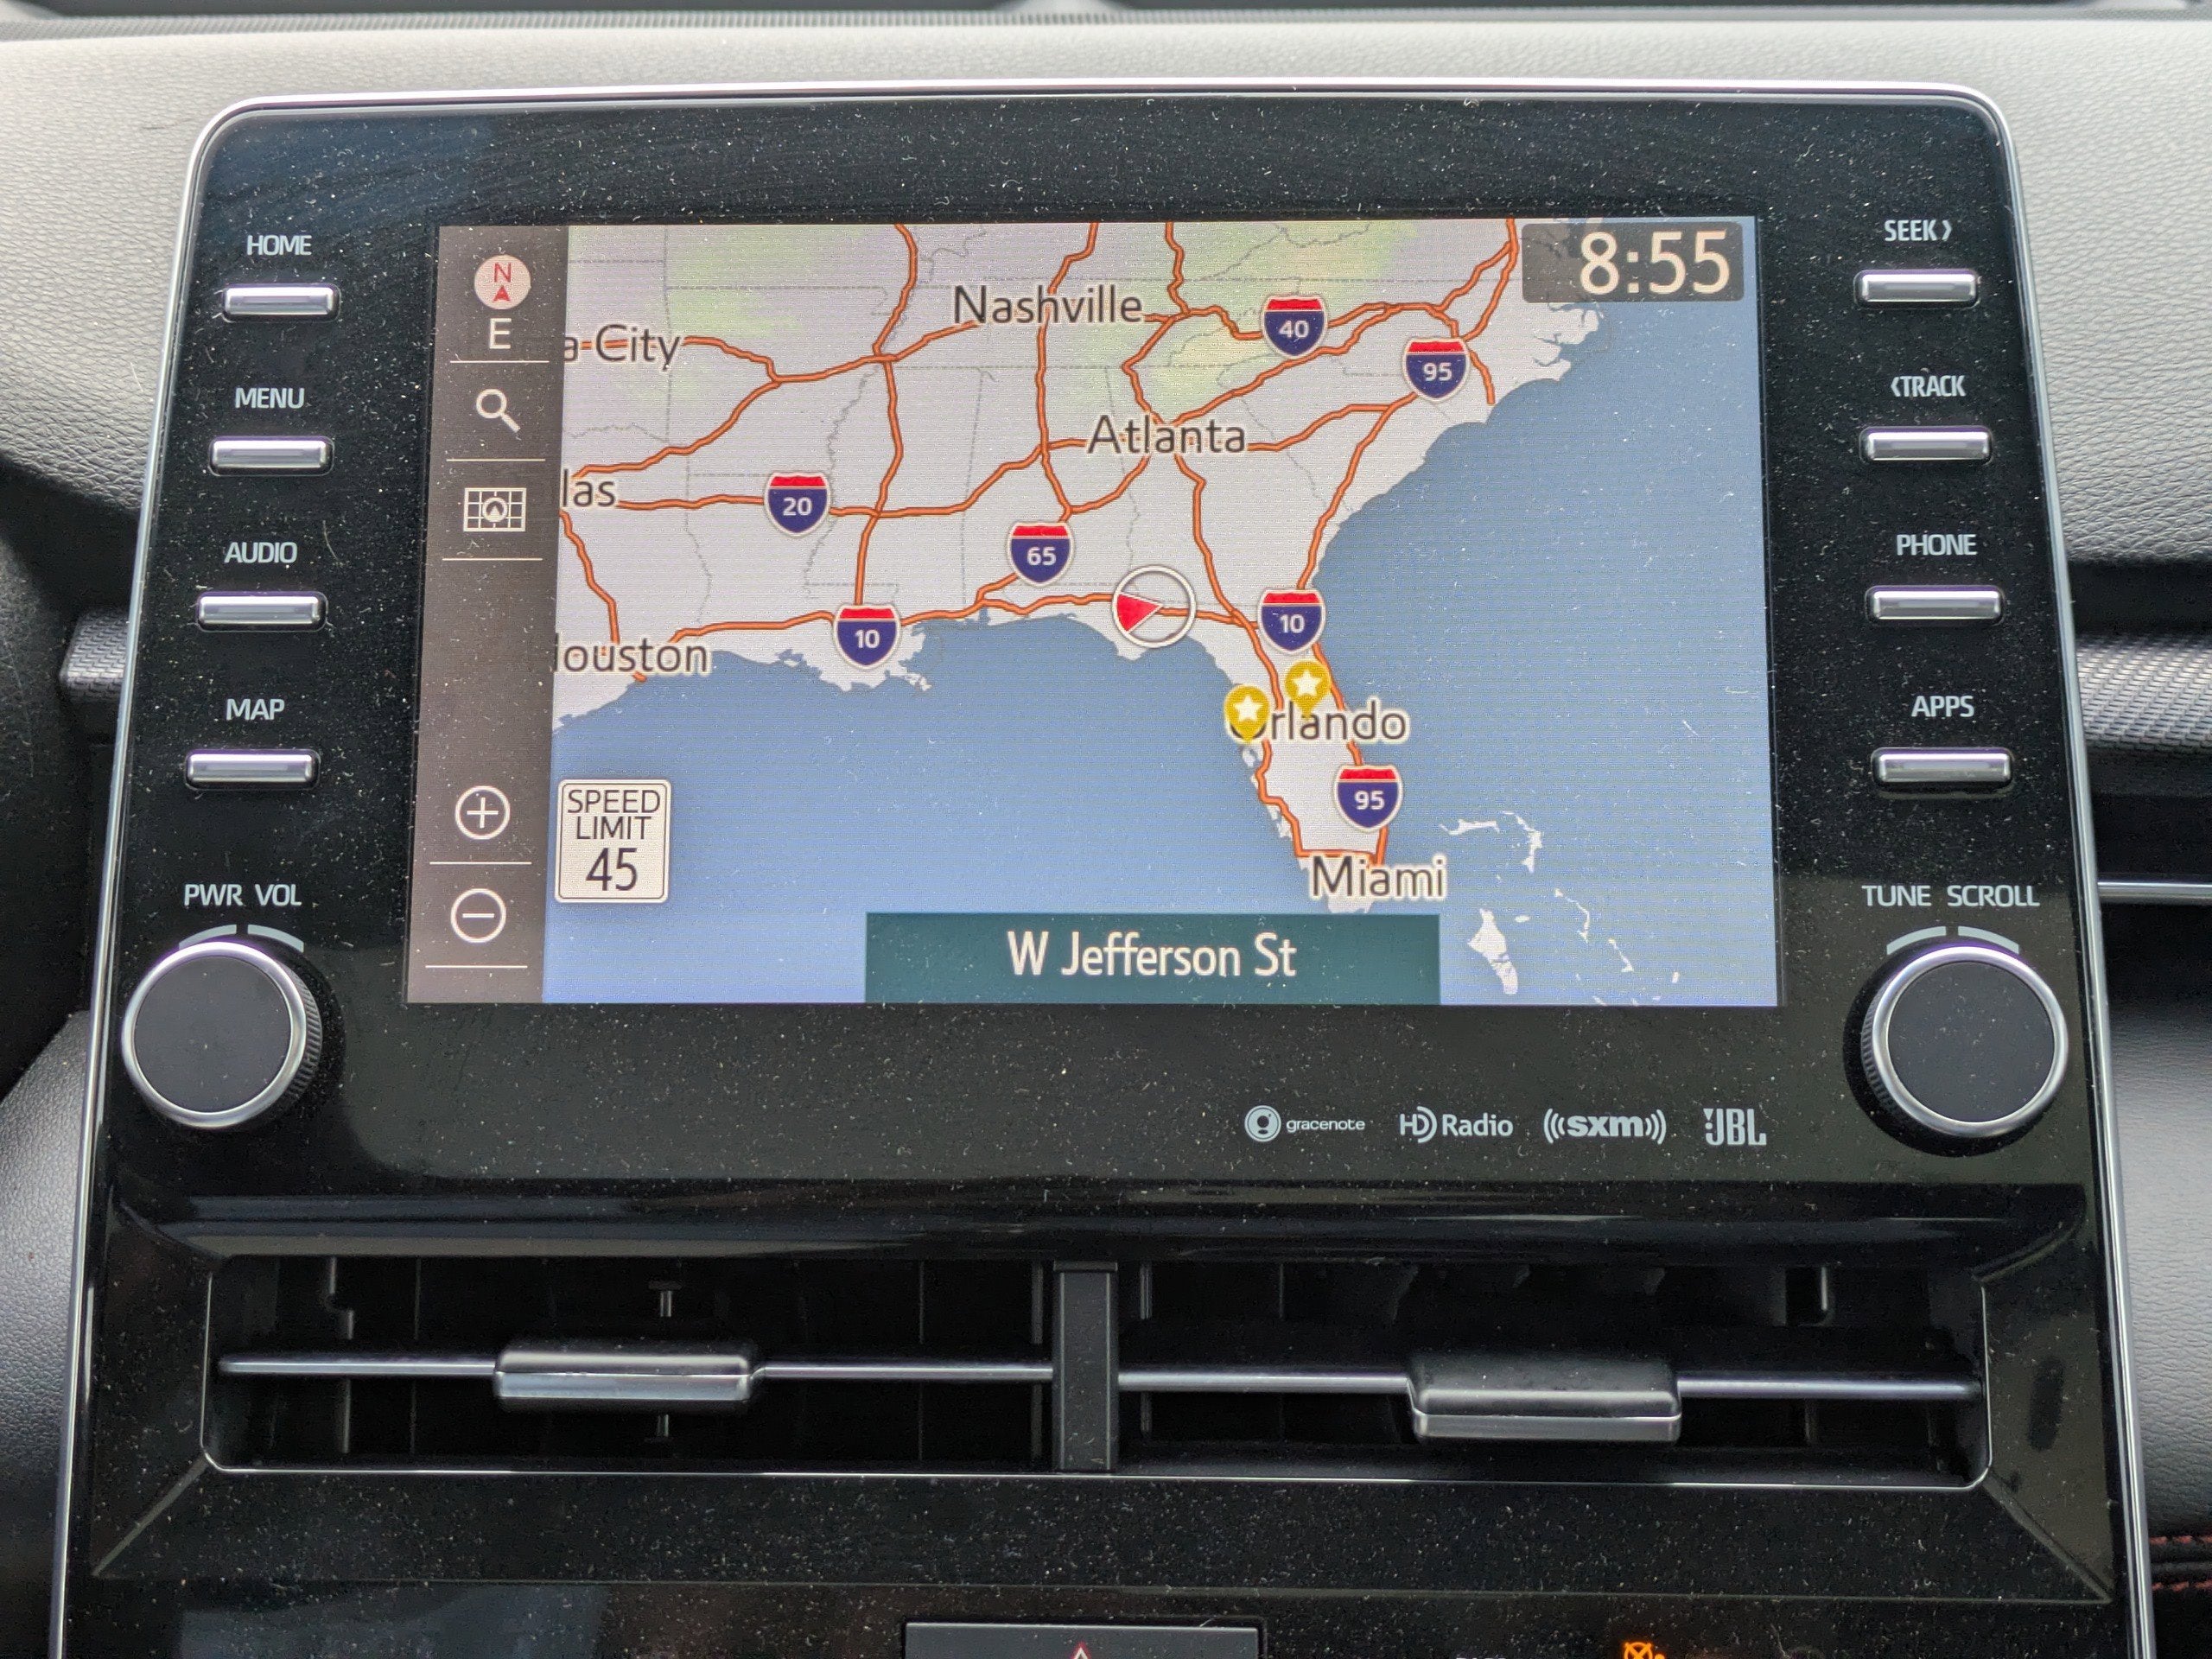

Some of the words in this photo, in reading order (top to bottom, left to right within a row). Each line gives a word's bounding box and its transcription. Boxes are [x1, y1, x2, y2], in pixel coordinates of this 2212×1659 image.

[246, 234, 312, 257] HOME
[493, 262, 512, 283] N
[1578, 229, 1730, 296] 8:55
[953, 284, 1143, 325] Nashville
[488, 317, 512, 349] E
[1278, 320, 1309, 340] 40
[595, 323, 681, 372] City
[1423, 361, 1452, 382] 95
[234, 387, 305, 410] MENU
[1086, 413, 1246, 454] Atlanta
[782, 497, 813, 517] 20
[223, 541, 298, 564] AUDIO
[1026, 546, 1057, 566] 65
[1896, 533, 1977, 556] PHONE
[1279, 613, 1306, 633] 10
[855, 630, 881, 649] 10
[555, 632, 707, 671] ouston
[226, 698, 285, 721] MAP
[1910, 696, 1975, 718] APPS
[1230, 699, 1407, 740] rlando
[567, 789, 661, 814] SPEED
[1353, 790, 1385, 810] 95
[575, 816, 652, 840] LIMIT
[585, 847, 639, 892] 45
[1311, 855, 1447, 899] Miami
[183, 884, 243, 906] PWR
[254, 884, 302, 906] VOL
[1862, 885, 1932, 907] TUNE
[1946, 885, 2040, 907] SCROLL
[1007, 931, 1050, 976] W
[1060, 931, 1241, 977] Jefferson
[1253, 931, 1297, 977] St
[1286, 1118, 1365, 1133] gracenote
[1400, 1106, 1438, 1143] HD
[1441, 1112, 1513, 1136] Radio
[1702, 1108, 1767, 1146] JBL
